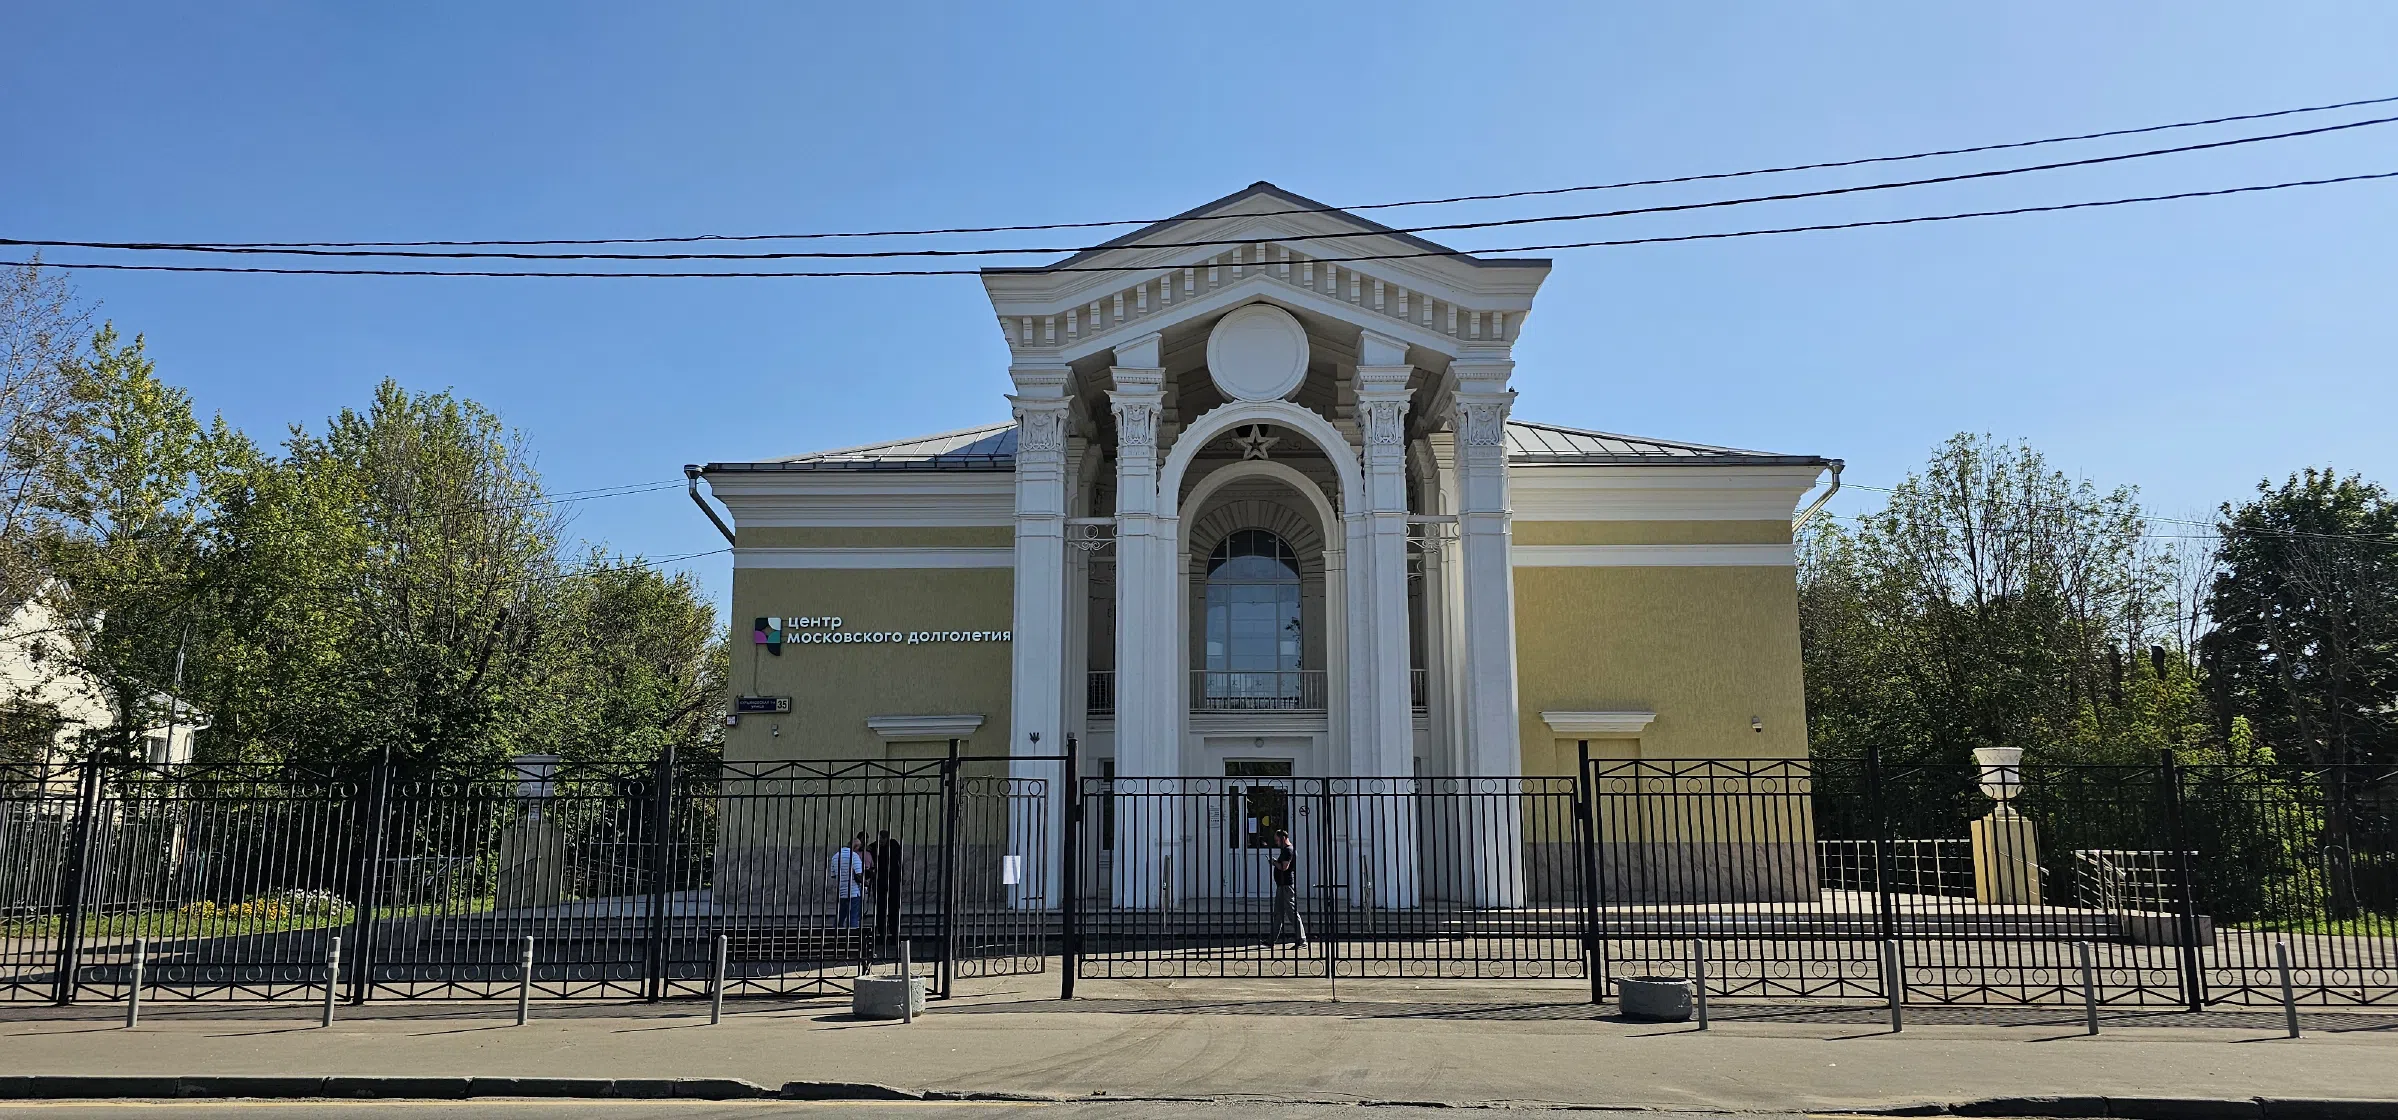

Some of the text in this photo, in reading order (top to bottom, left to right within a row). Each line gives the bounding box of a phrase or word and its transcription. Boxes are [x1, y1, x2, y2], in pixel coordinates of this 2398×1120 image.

[788, 616, 842, 630] центр
[787, 631, 1011, 645] московского долголетия
[777, 700, 787, 709] 35
